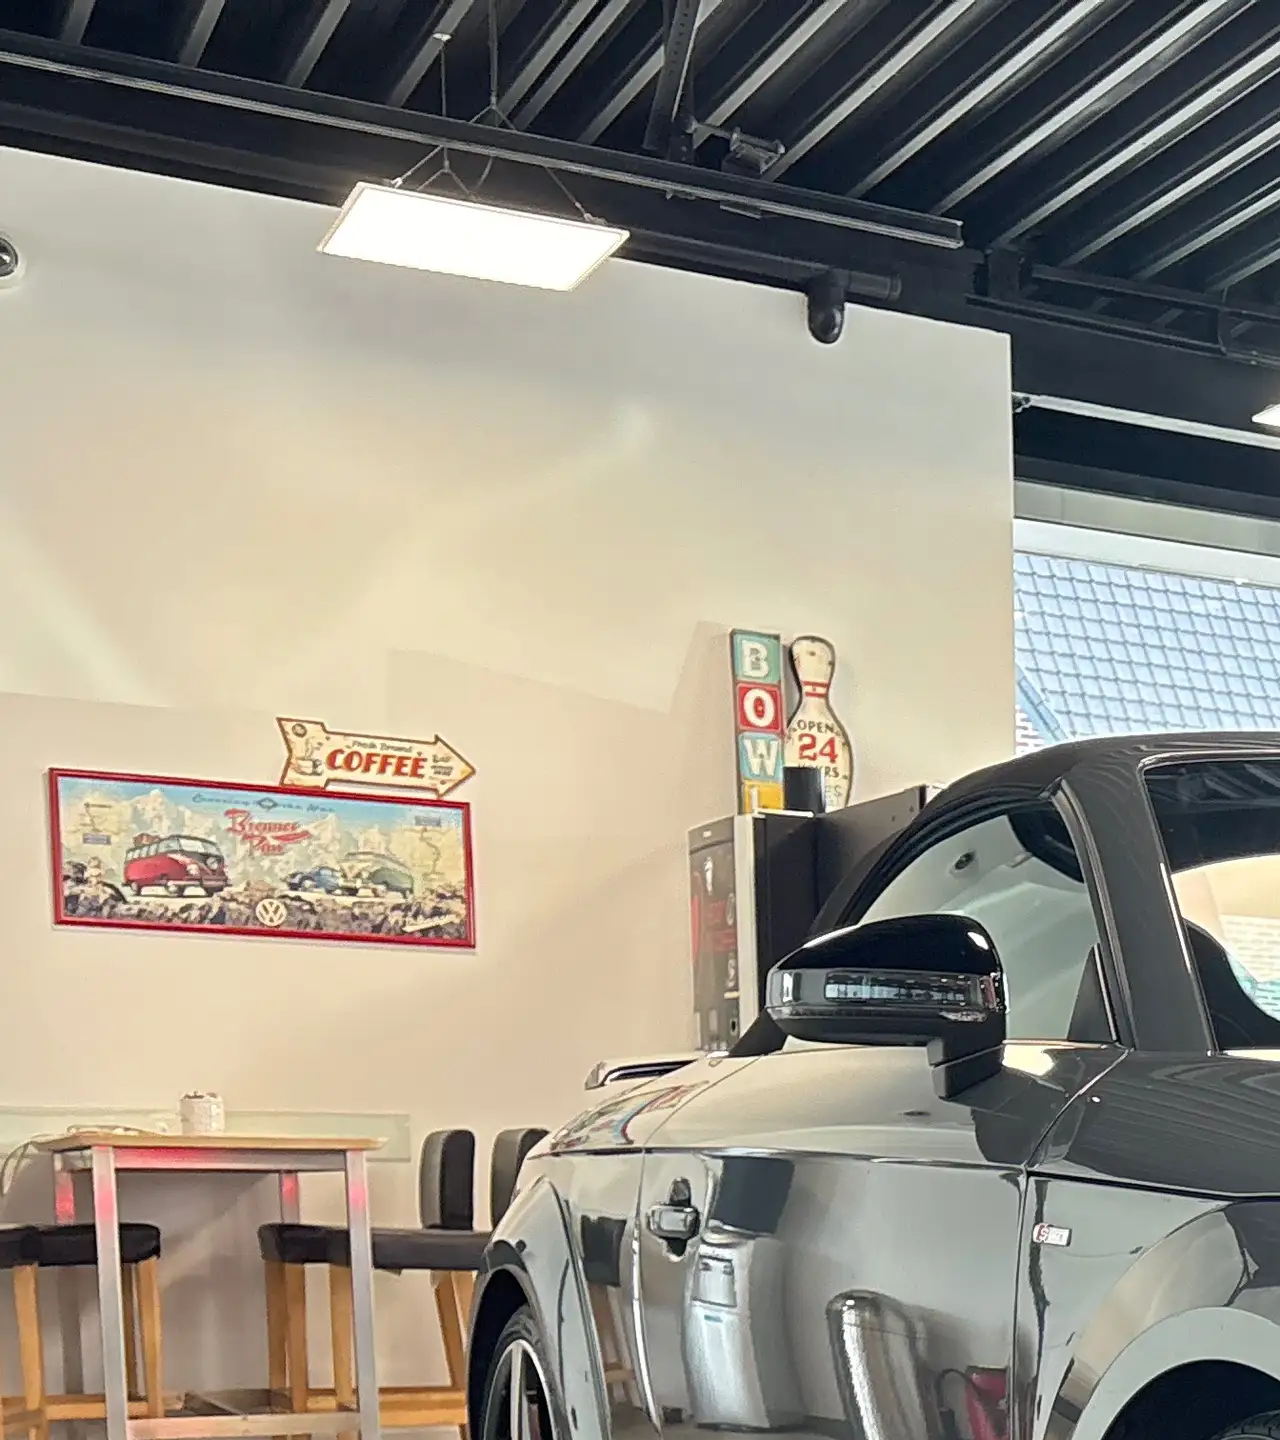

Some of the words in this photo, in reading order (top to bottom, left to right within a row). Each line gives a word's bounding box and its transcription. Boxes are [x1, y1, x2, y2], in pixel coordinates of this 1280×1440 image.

[797, 719, 834, 734] OPEN
[326, 748, 427, 778] COFFEE
[798, 733, 838, 763] 24
